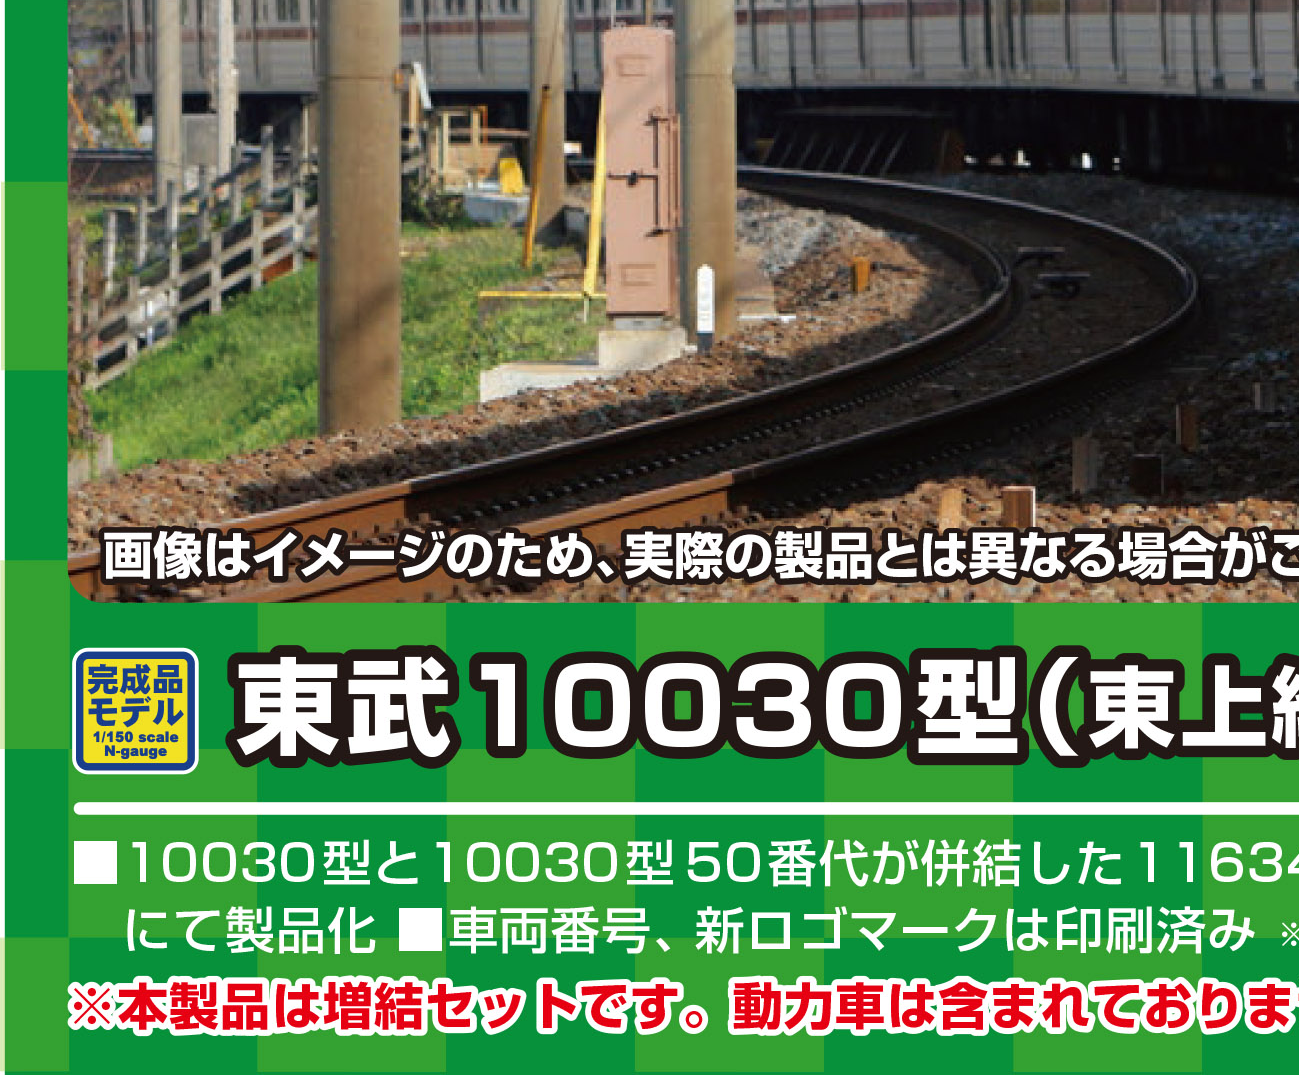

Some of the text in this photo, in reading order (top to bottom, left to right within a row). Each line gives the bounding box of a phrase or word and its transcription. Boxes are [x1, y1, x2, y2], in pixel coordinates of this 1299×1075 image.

[87, 663, 183, 695] 完成品
[88, 696, 184, 728] モデル
[93, 731, 179, 743] 1/150 scale
[104, 745, 168, 760] N-gauge
[126, 906, 377, 955] にて製品化
